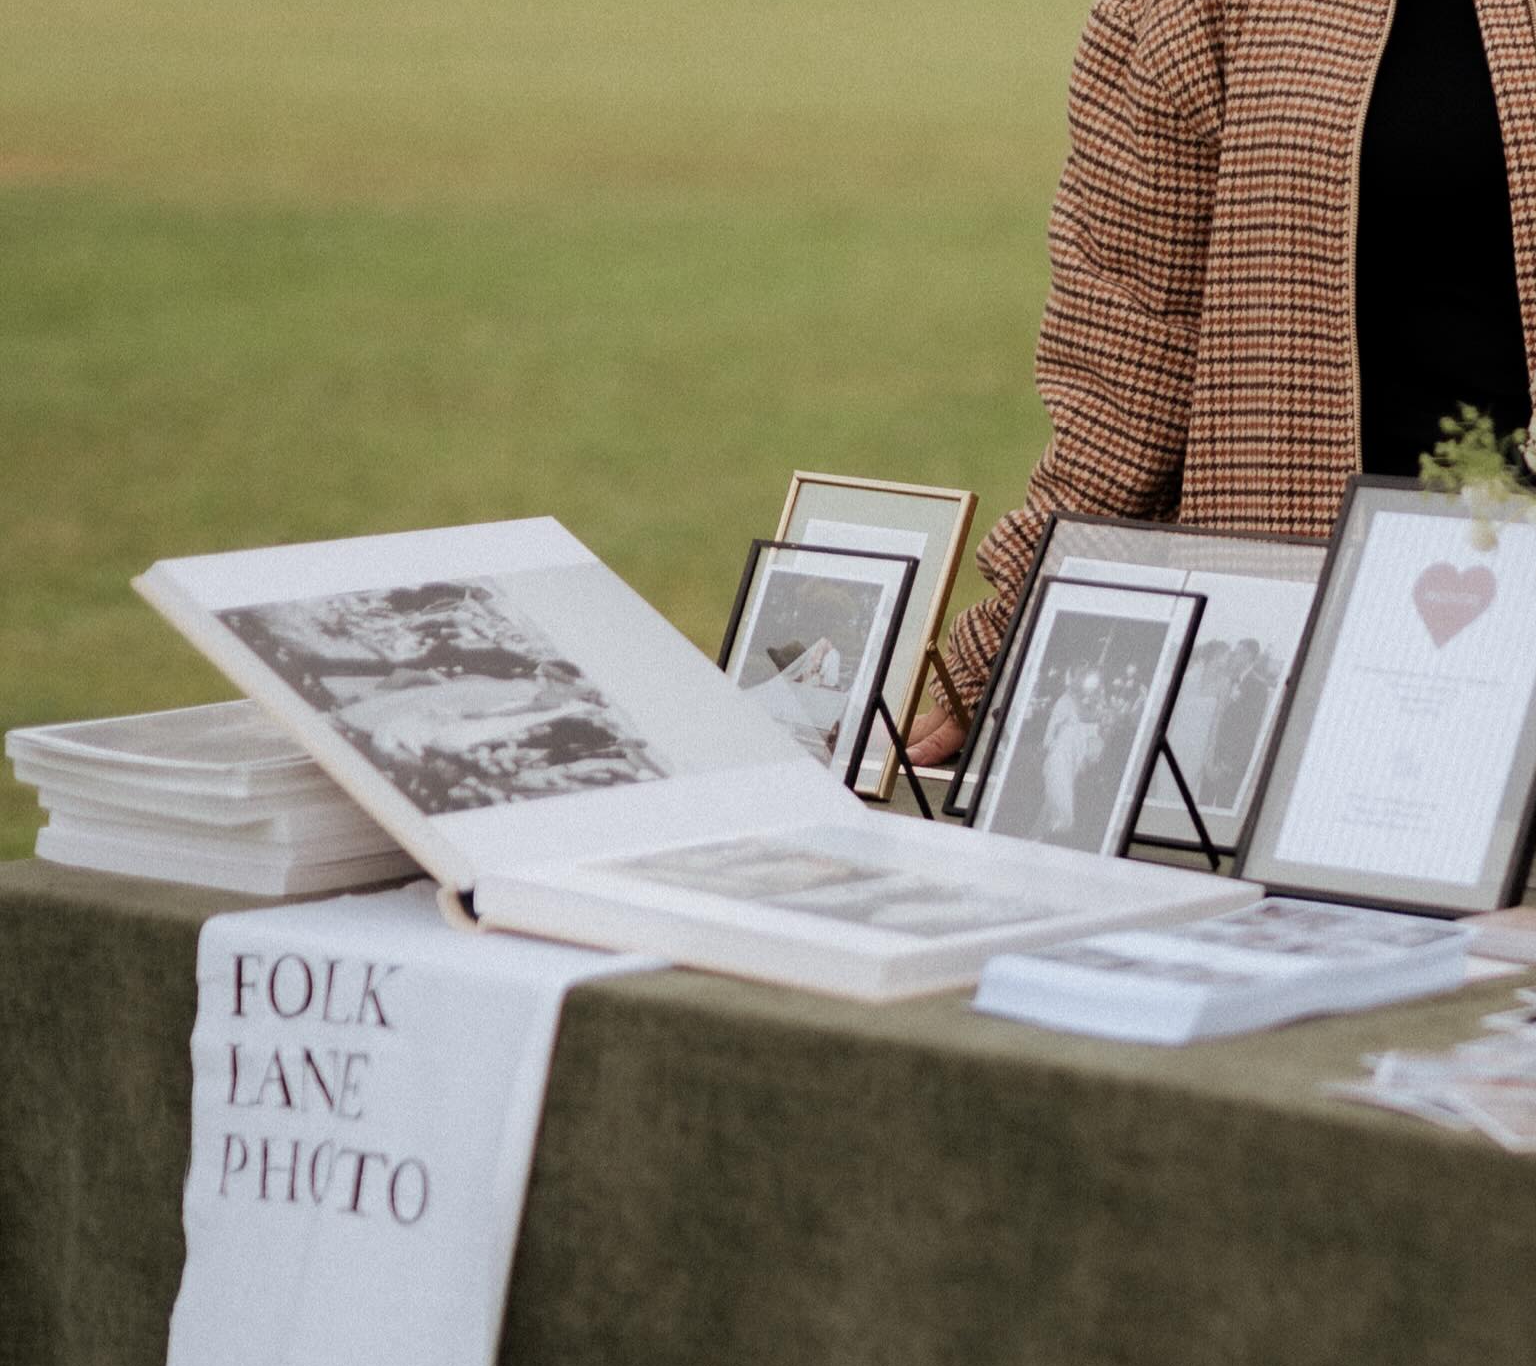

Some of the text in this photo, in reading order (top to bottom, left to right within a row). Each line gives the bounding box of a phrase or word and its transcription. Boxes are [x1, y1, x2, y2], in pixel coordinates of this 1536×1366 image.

[230, 953, 403, 1030] FOLK
[226, 1043, 370, 1120] LANE
[219, 1134, 430, 1226] PHOTO
